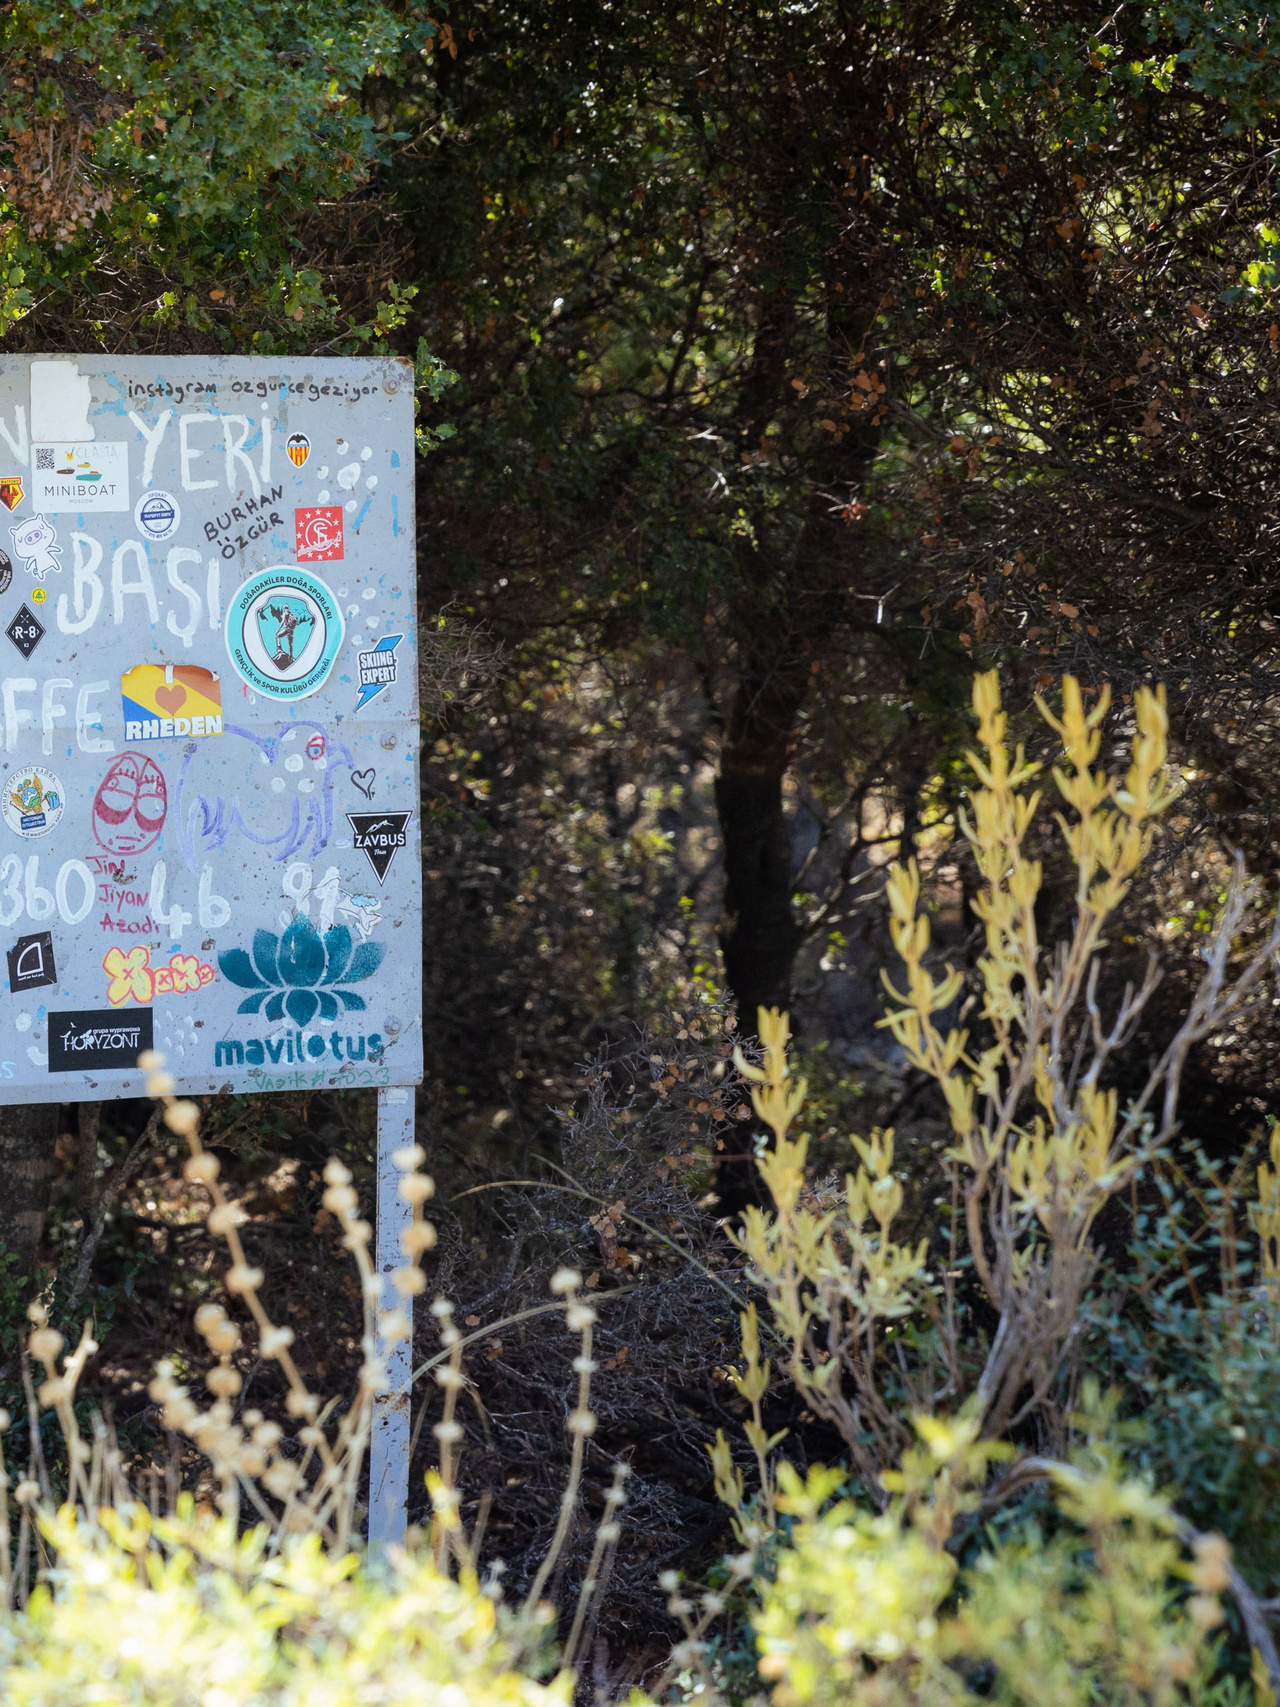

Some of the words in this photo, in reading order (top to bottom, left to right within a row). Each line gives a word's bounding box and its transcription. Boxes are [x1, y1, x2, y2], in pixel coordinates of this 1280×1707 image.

[128, 379, 217, 404] instagram
[44, 484, 117, 496] MINIBOAT
[204, 485, 283, 542] BURHAN
[217, 512, 284, 560] ÖZGÜR
[239, 576, 285, 610] DOĞADAKİLER
[286, 576, 308, 589] DOĞA
[308, 585, 333, 620] SPORLARI
[234, 648, 255, 679] GENÇLİK
[253, 676, 262, 686] ve
[261, 682, 280, 693] SPOR
[360, 650, 394, 669] SKIING
[361, 666, 396, 685] EXPERT
[125, 715, 222, 740] RHEDEN
[2, 767, 33, 816] МИНИСТЕРСТВО
[35, 767, 56, 782] КАЙФА
[355, 833, 405, 847] ZAVBUS
[150, 859, 232, 940] 46
[99, 912, 160, 934] Azadi
[214, 1030, 385, 1067] mavilotus
